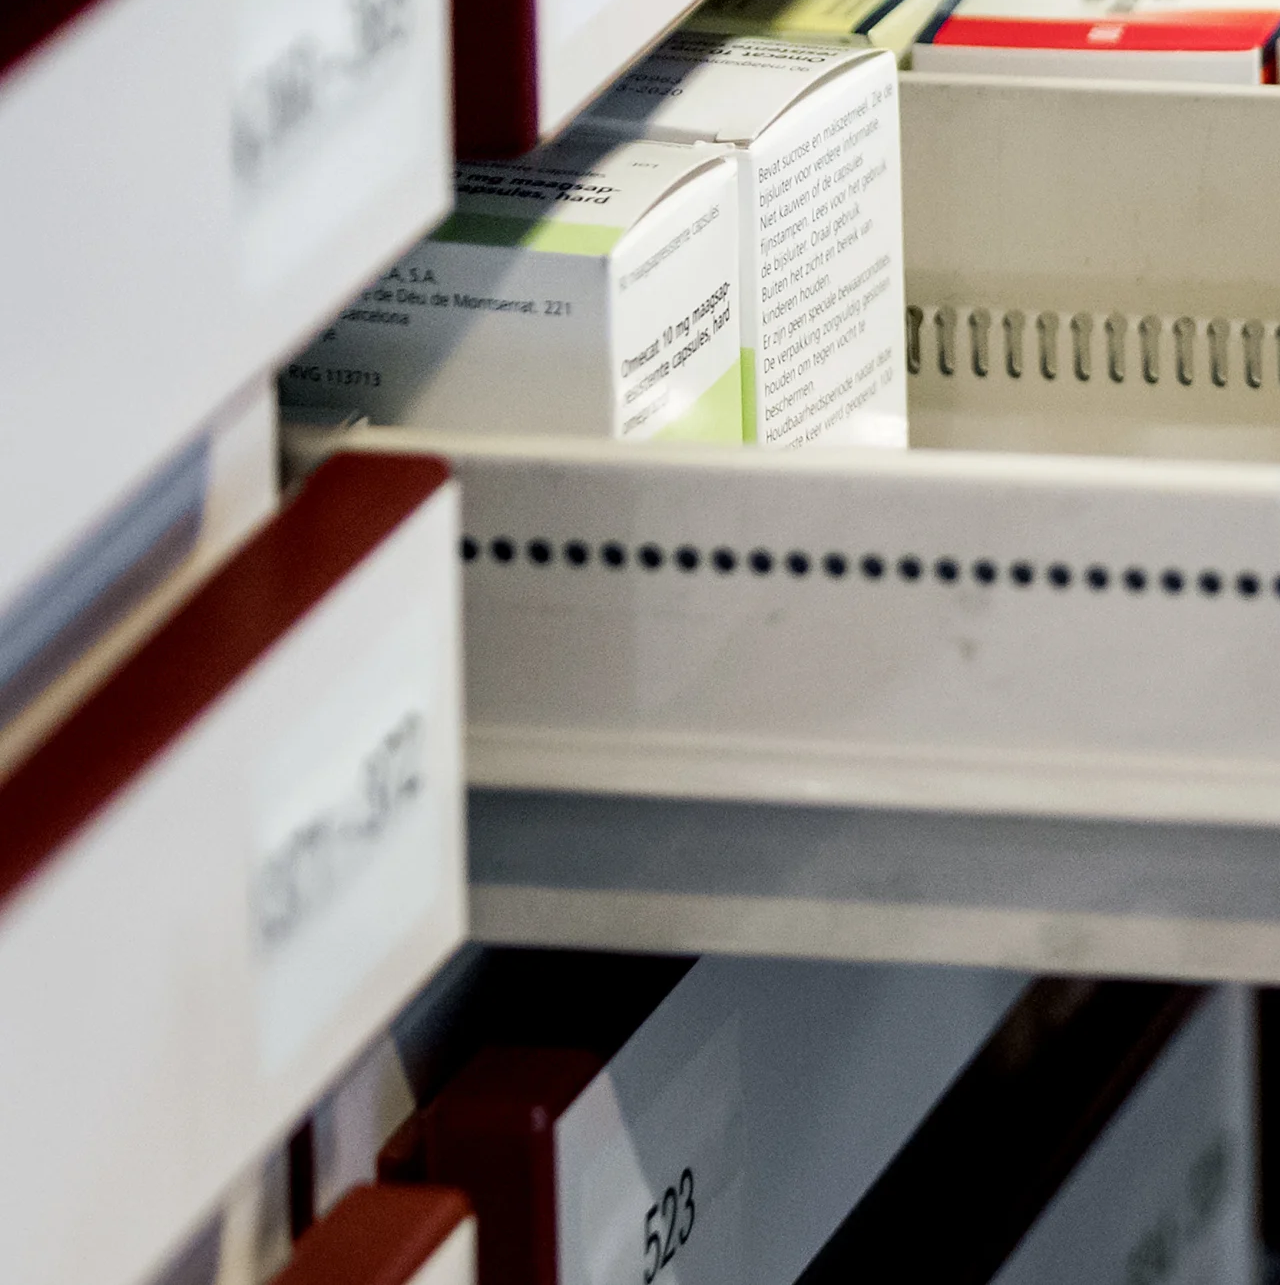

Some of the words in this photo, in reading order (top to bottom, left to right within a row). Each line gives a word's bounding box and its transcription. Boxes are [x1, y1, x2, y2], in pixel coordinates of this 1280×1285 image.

[758, 159, 781, 184] Bevat
[782, 140, 811, 170] sucrose
[811, 132, 822, 149] en
[457, 184, 546, 201] apsules,
[555, 190, 611, 205] hard
[509, 177, 622, 195] maagsap-
[759, 174, 793, 208] bijsluiter
[794, 164, 812, 185] voor
[760, 210, 778, 231] Niet
[779, 190, 811, 220] kauwen
[811, 179, 820, 199] of
[821, 172, 832, 192] de
[811, 202, 829, 223] Lees
[830, 189, 848, 210] voor
[760, 259, 772, 279] de
[810, 224, 832, 248] Oraal
[761, 275, 789, 303] Buiten
[789, 263, 804, 282] het
[825, 244, 835, 261] en
[544, 300, 571, 316] 221
[713, 299, 731, 335] hard
[762, 295, 798, 327] kinderen
[621, 338, 660, 379] Omecat
[662, 324, 673, 346] 10
[675, 316, 691, 338] mg
[763, 333, 771, 350] Er
[788, 312, 807, 338] geen
[327, 368, 381, 387] 113713
[763, 357, 776, 375] De
[764, 368, 796, 398] houden
[798, 358, 811, 376] om
[813, 341, 836, 367] tegen
[644, 1167, 695, 1285] 523
